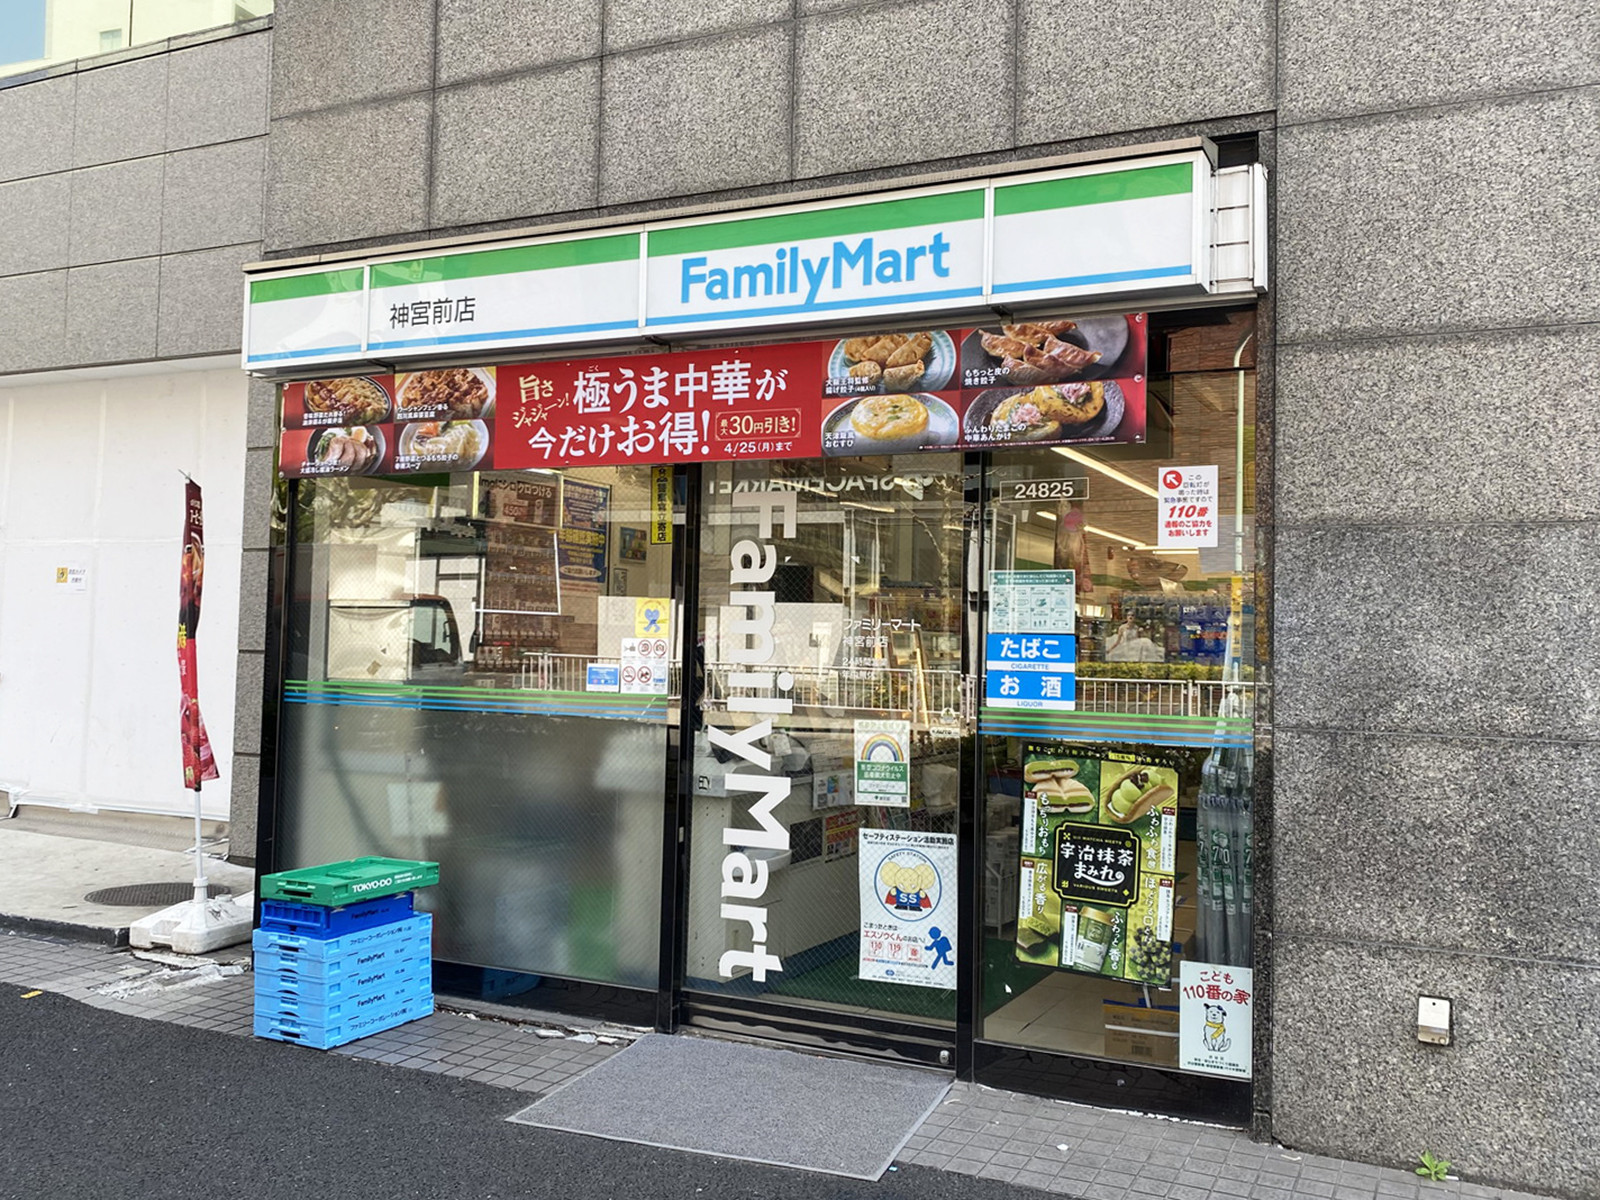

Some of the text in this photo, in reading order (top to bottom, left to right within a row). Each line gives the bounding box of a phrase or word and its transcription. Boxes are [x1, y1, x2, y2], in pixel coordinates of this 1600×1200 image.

[681, 231, 951, 307] FamilyMart
[389, 296, 477, 329] 神宮前店
[964, 376, 997, 386] 焼き餃子
[965, 367, 1010, 377] もちっと皮の
[519, 375, 553, 402] 旨さ
[573, 360, 789, 414] 極うま中華が
[528, 409, 711, 460] 今だけお得!
[825, 440, 854, 448] おむすび
[1014, 481, 1074, 499] 24825
[1168, 504, 1209, 518] 110番
[843, 618, 922, 632] ファミリーマート
[1000, 637, 1061, 659] たばこ
[1011, 662, 1050, 670] CIGARETTE
[1000, 674, 1062, 698] お酒
[1017, 700, 1043, 708] LIQUOR
[708, 491, 797, 983] FamilyMart
[1060, 842, 1133, 866] 宇治抹茶
[1074, 861, 1125, 886] まみれ
[899, 893, 918, 904] SS
[1109, 912, 1124, 971] ふわっと香る
[357, 952, 385, 965] FamilyMart
[357, 972, 385, 985] FamilyMart
[1200, 970, 1234, 985] こども
[357, 993, 385, 1007] FamilyMart
[1183, 984, 1251, 1006] 110番の家
